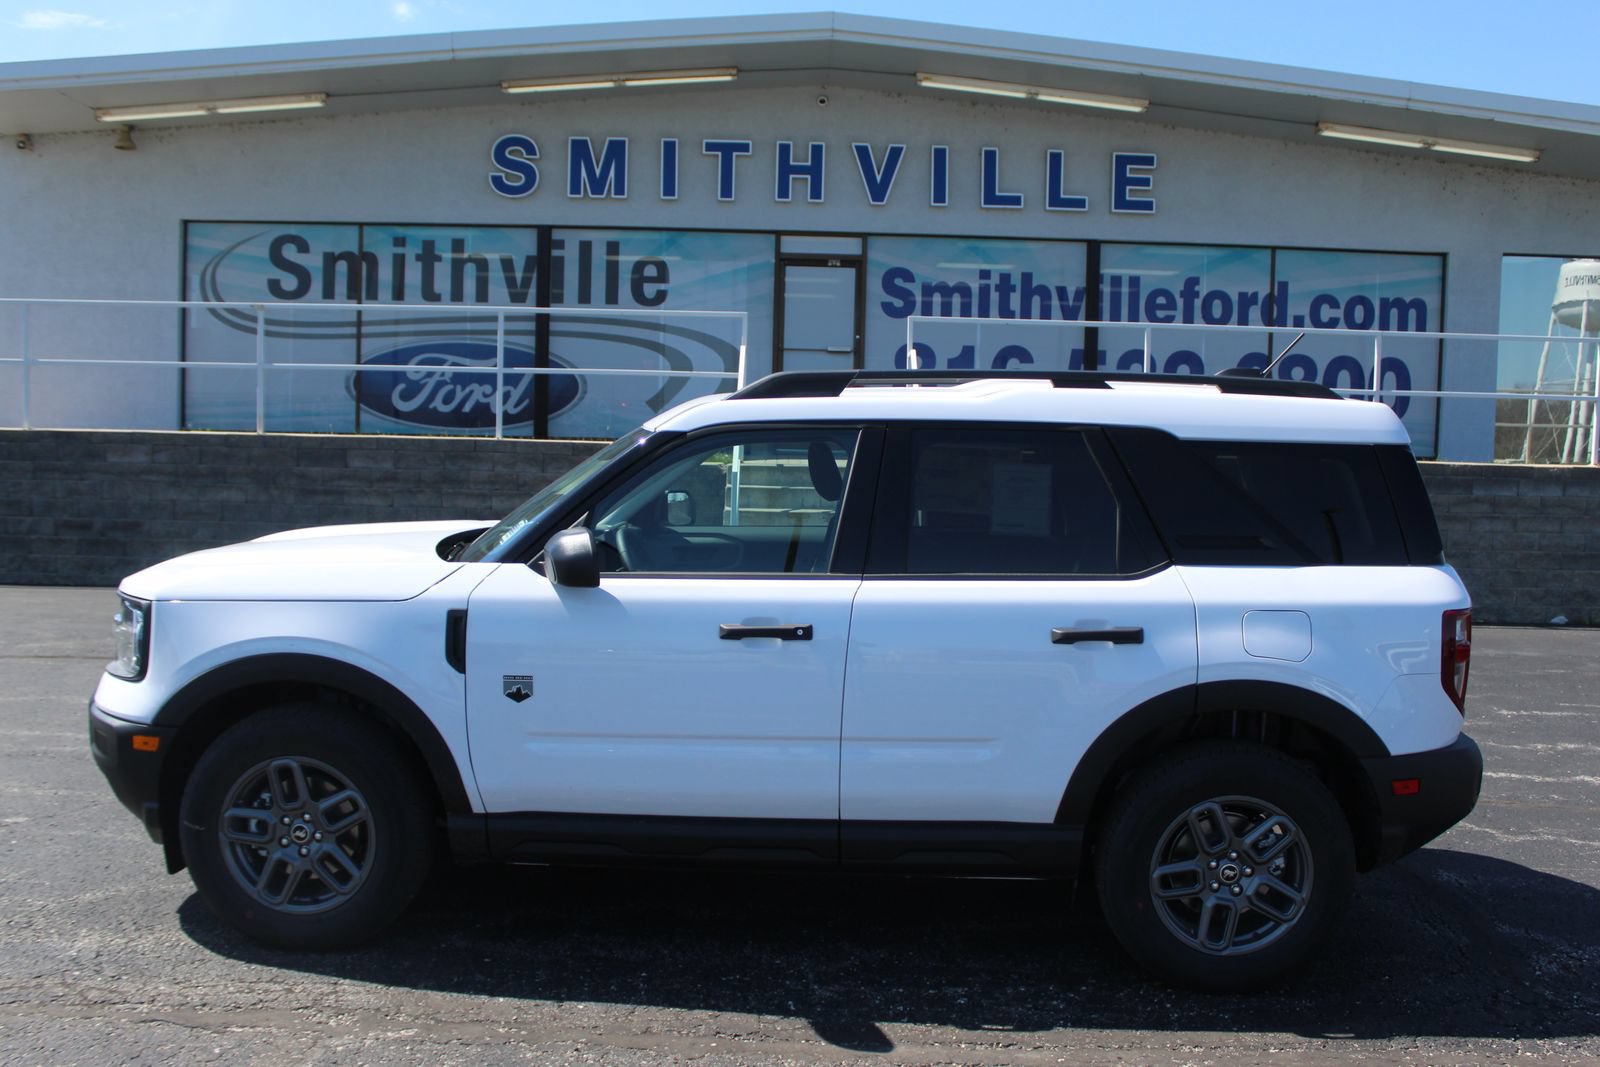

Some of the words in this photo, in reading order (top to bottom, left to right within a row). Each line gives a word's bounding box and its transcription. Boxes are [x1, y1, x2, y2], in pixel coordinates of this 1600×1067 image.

[488, 133, 1157, 214] SMITHVILLE
[266, 234, 671, 307] Smithville
[391, 352, 535, 415] Ford
